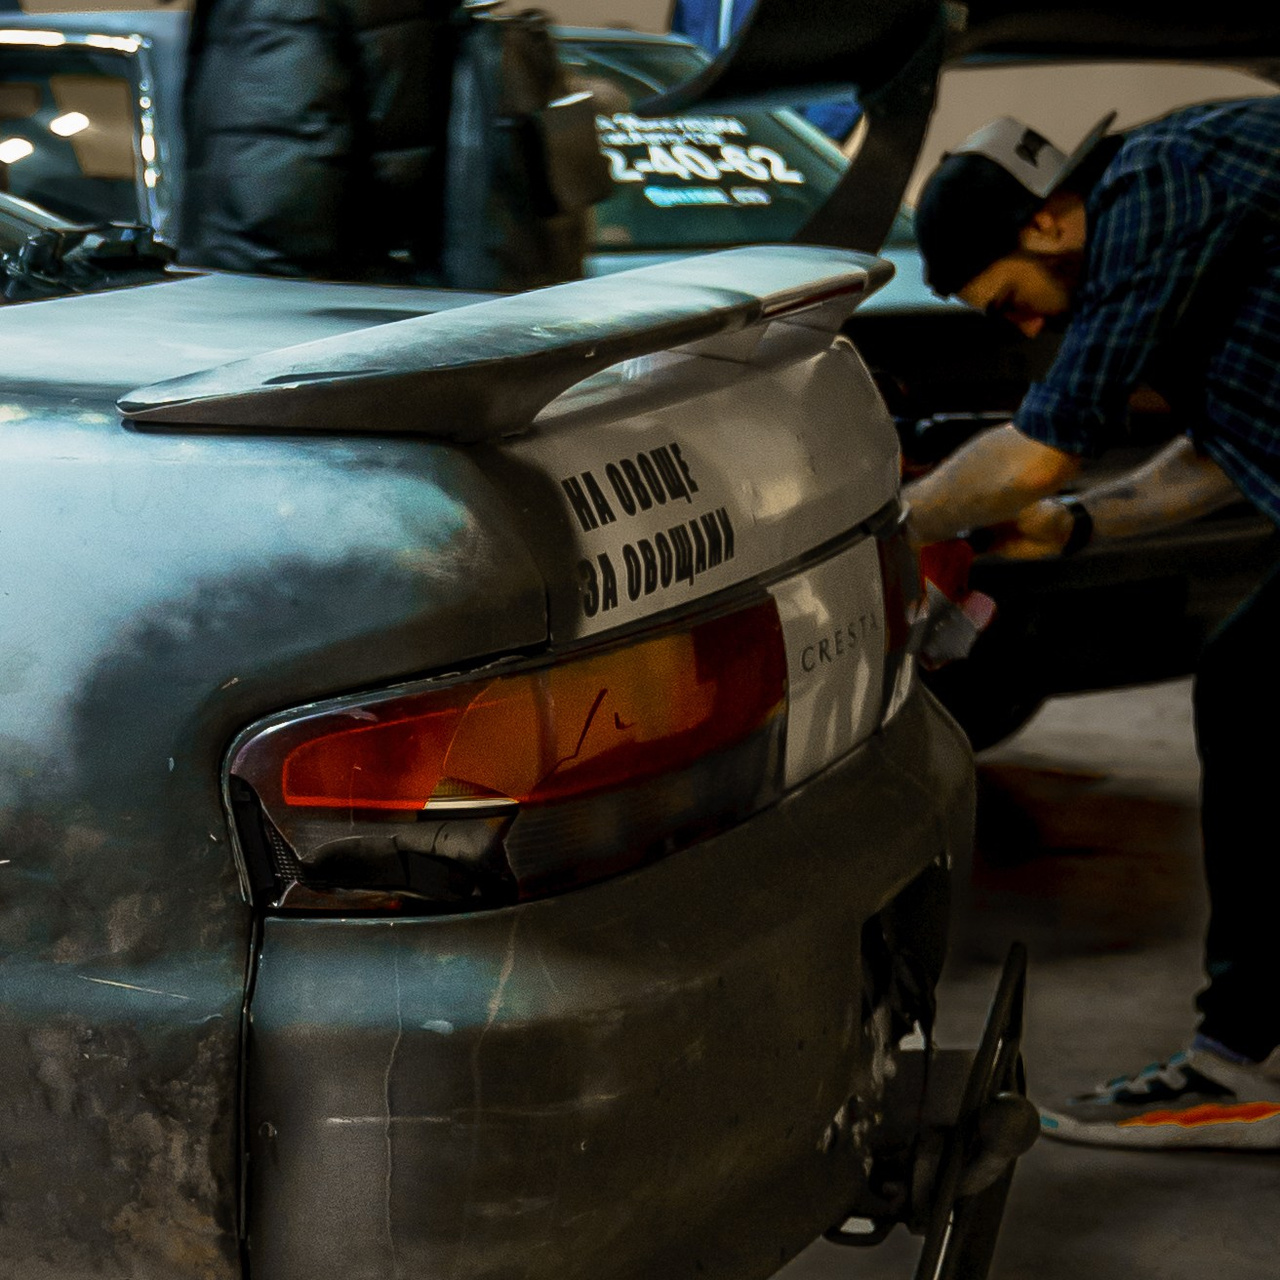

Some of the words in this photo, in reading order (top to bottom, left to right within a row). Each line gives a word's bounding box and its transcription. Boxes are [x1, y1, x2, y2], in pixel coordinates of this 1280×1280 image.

[561, 470, 617, 533] НА
[605, 442, 699, 517] ОВОЩЕ
[580, 554, 618, 618] ЗА
[623, 507, 735, 601] ОВОЩАМИ
[801, 614, 880, 672] CRESTA
